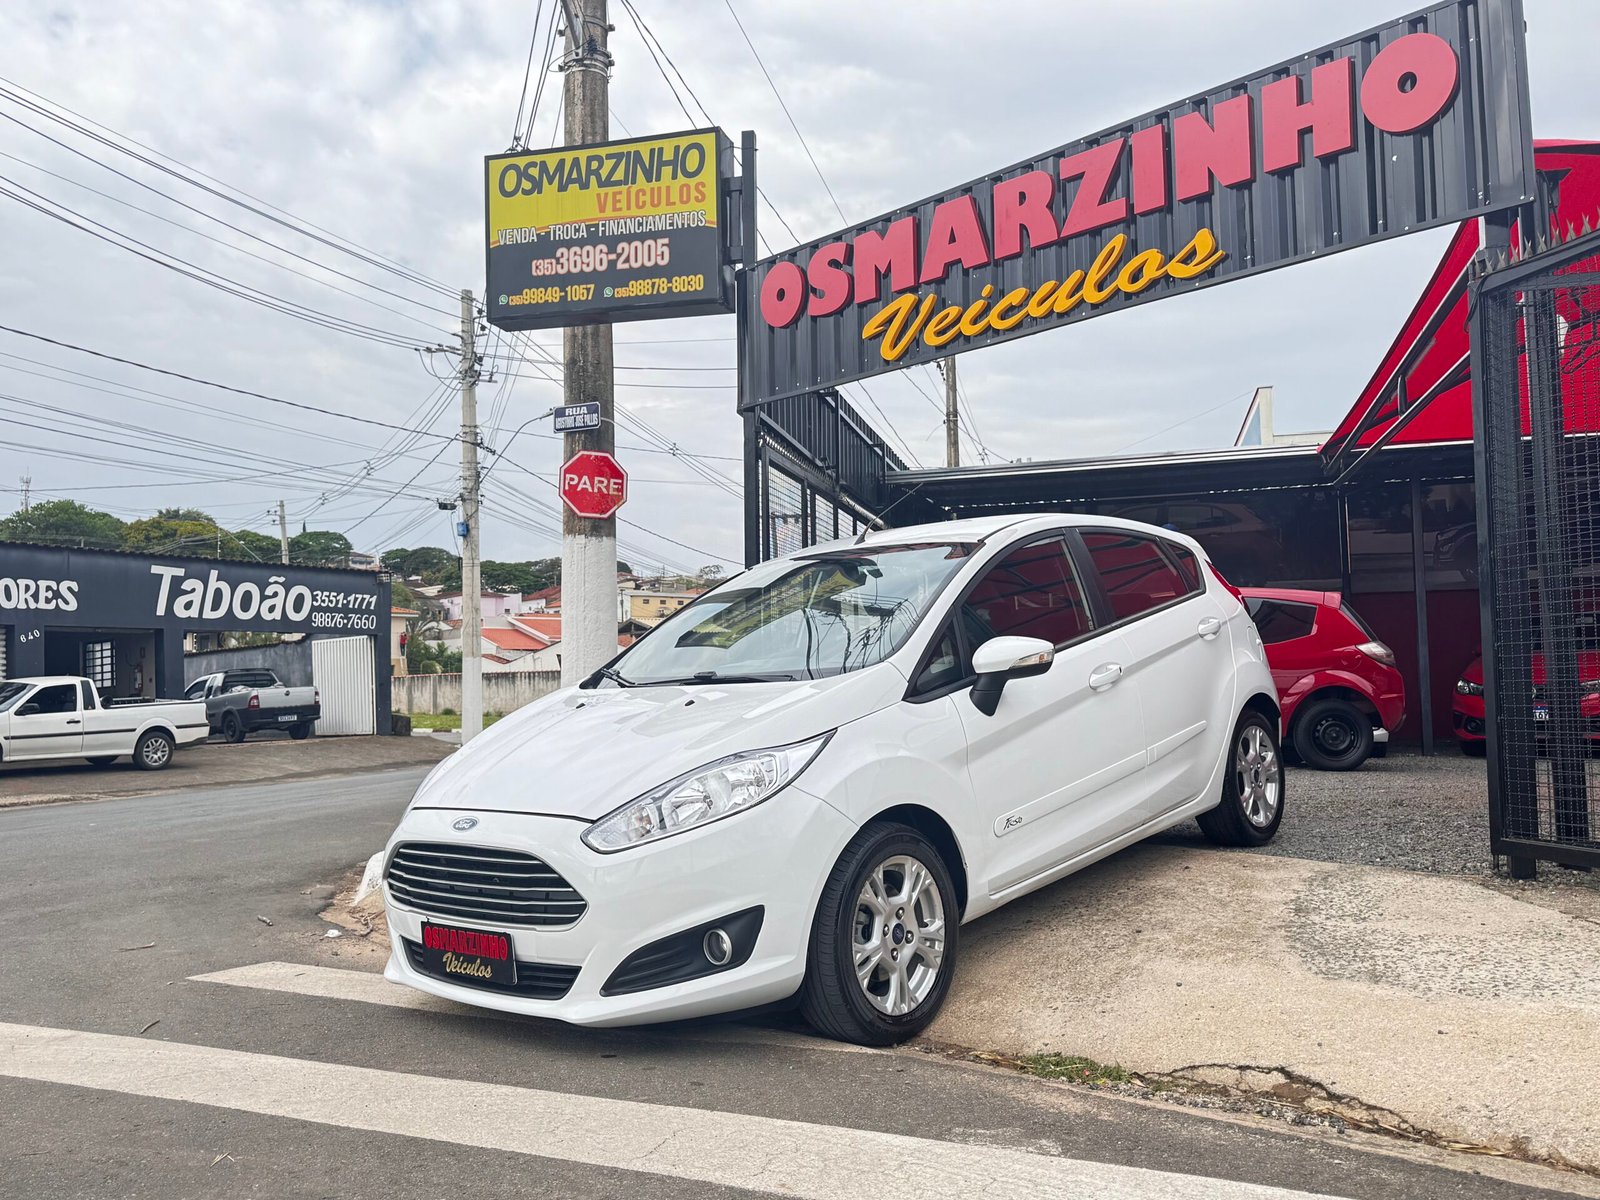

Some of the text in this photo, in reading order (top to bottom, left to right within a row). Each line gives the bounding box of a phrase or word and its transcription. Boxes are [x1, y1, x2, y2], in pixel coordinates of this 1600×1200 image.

[498, 142, 706, 198] OSMARZINHO
[759, 32, 1459, 329] OSMARZINHO
[595, 181, 707, 214] VEÍCULOS
[498, 227, 538, 246] VENDA
[549, 223, 588, 242] TROCA
[598, 210, 706, 236] FINANCIAMENTOS
[531, 238, 670, 277] (35)3696-2005
[565, 406, 588, 416] RUA
[564, 474, 623, 496] PARE
[0, 577, 79, 612] ORES
[150, 564, 313, 622] Taboão
[424, 925, 508, 961] OSMARZINHO
